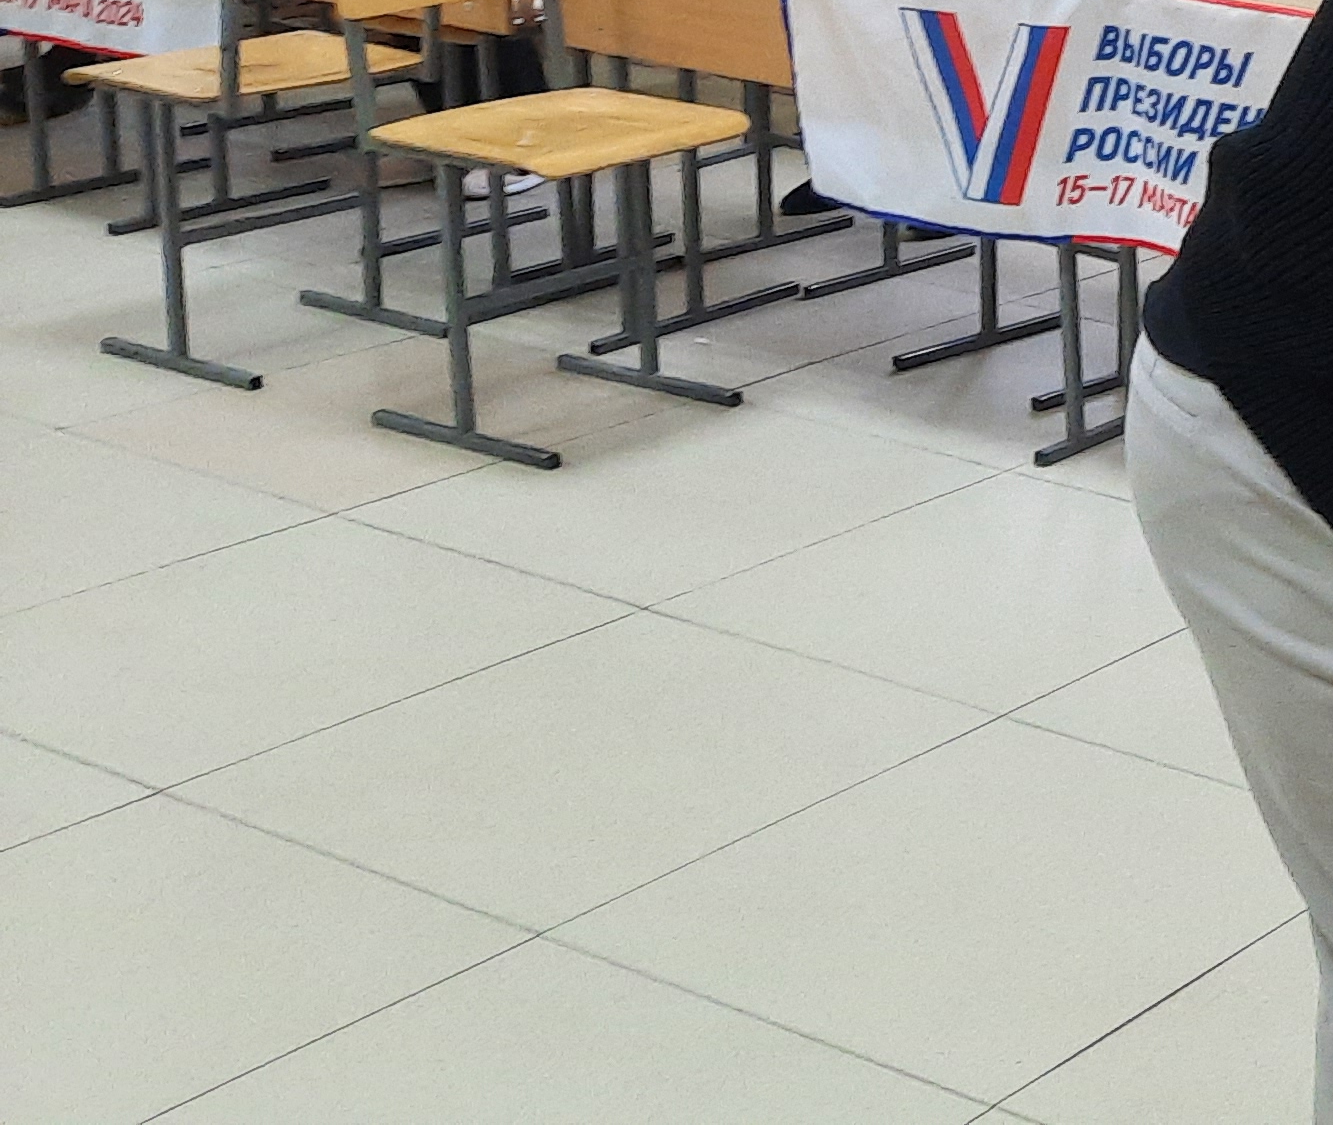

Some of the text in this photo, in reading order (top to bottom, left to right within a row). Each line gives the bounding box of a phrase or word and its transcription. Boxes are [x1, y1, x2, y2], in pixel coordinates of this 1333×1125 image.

[1093, 24, 1255, 88] ВЫБОРЫ
[1077, 75, 1268, 142] ПРЕЗИДЕН
[1062, 125, 1200, 185] РОССИИ
